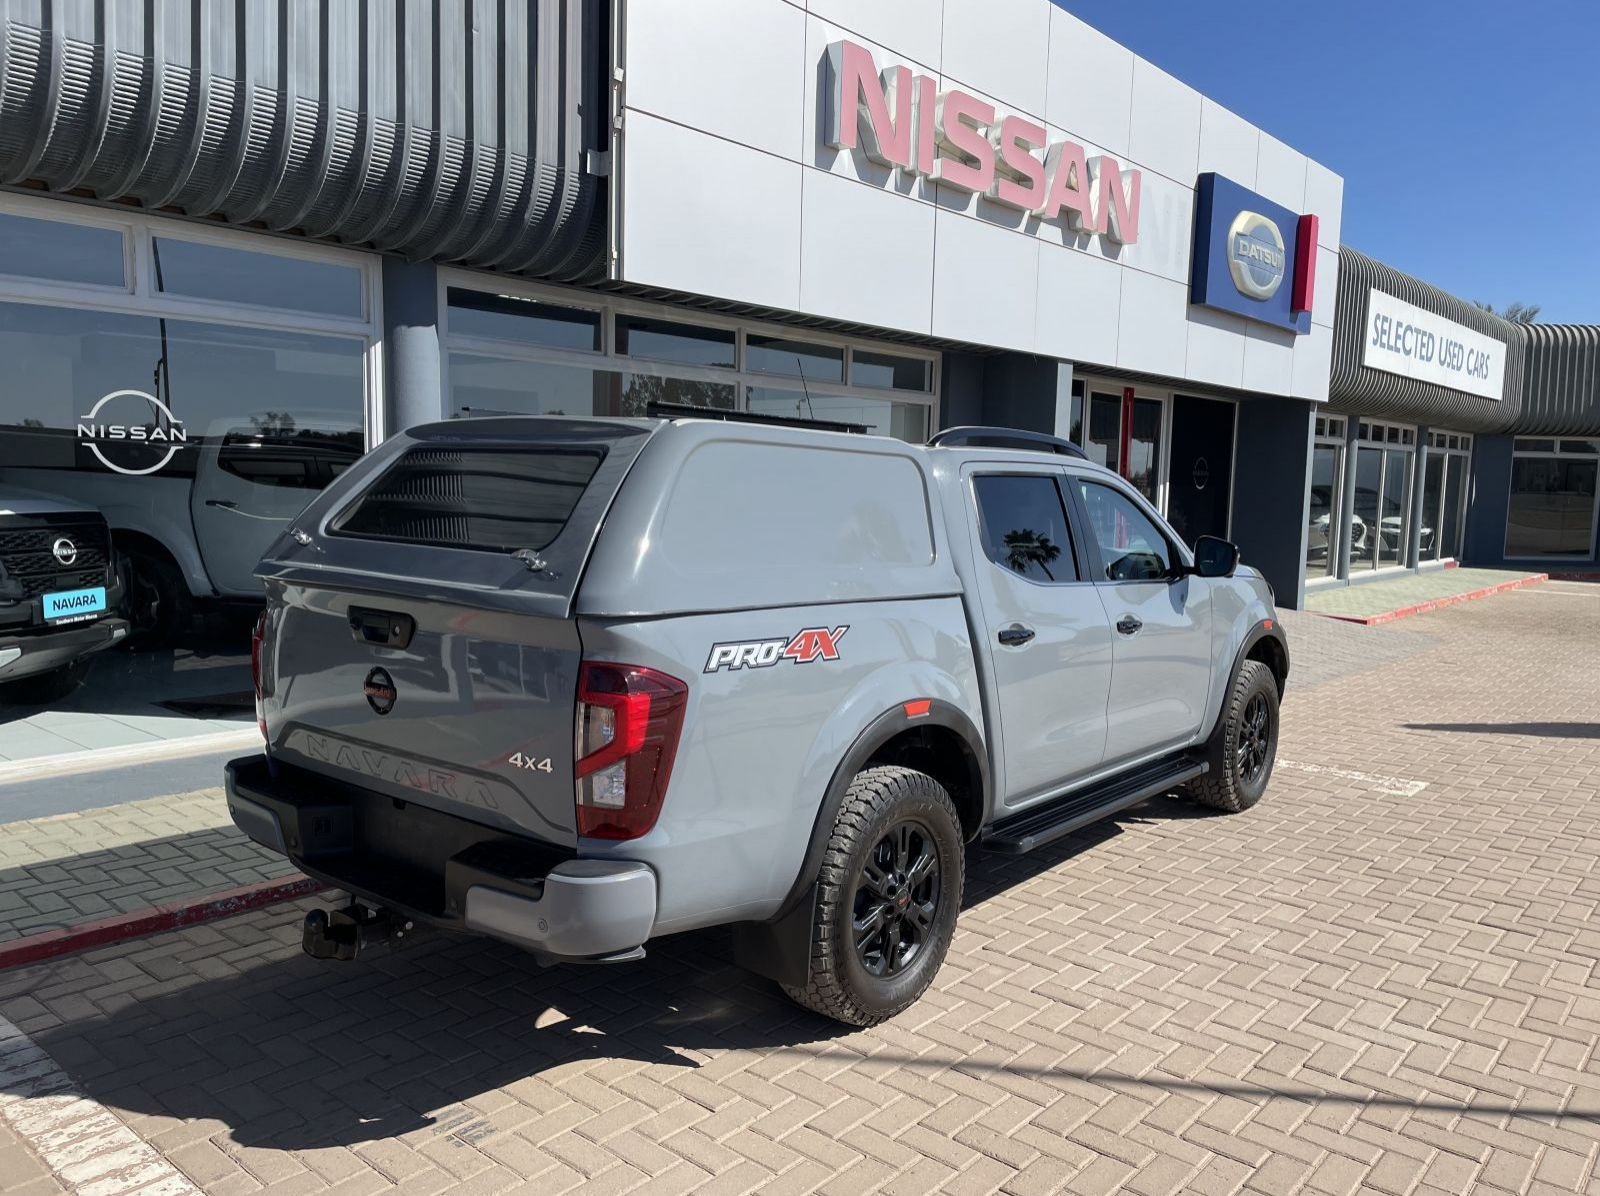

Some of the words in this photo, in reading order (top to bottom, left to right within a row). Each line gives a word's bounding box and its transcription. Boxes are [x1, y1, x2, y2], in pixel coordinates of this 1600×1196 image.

[840, 39, 1142, 245] NISSAN
[1372, 312, 1435, 362] SELECTED
[1438, 336, 1464, 371] USED
[1466, 348, 1491, 380] CARS
[77, 423, 187, 442] NISSAN
[52, 593, 97, 611] NAVARA
[508, 752, 554, 774] 4x4
